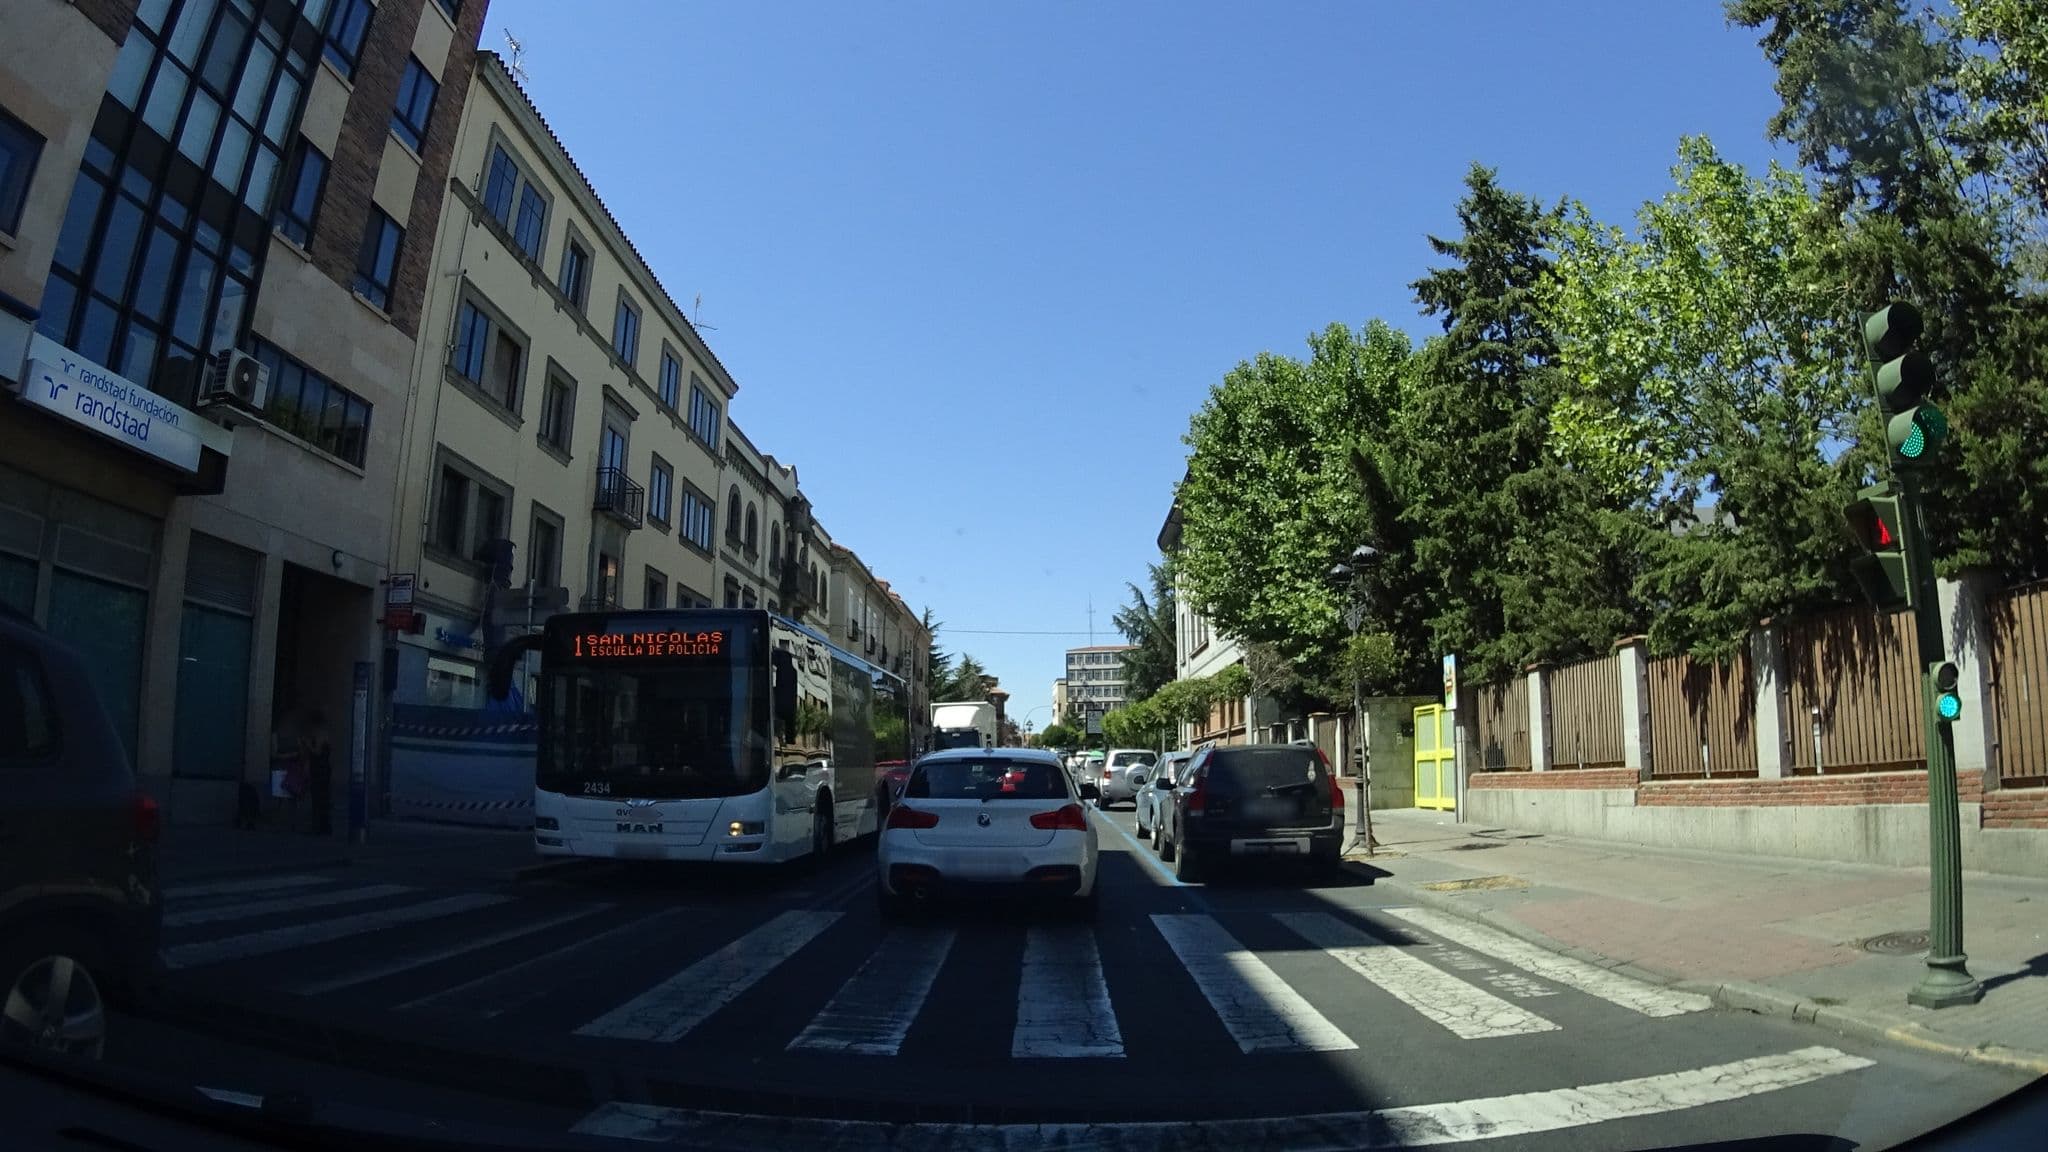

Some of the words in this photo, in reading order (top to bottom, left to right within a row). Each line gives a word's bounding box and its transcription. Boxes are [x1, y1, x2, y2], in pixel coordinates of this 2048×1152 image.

[80, 369, 128, 400] randstad
[130, 389, 179, 426] fundación
[75, 392, 151, 442] randstad
[575, 636, 582, 656] 1
[587, 634, 624, 645] SAN
[633, 632, 722, 644] NICOLAS
[591, 644, 643, 656] ESCUELA
[648, 644, 663, 656] DE
[668, 643, 719, 655] POLICIA
[583, 782, 611, 794] 2434
[616, 822, 664, 834] MAN
